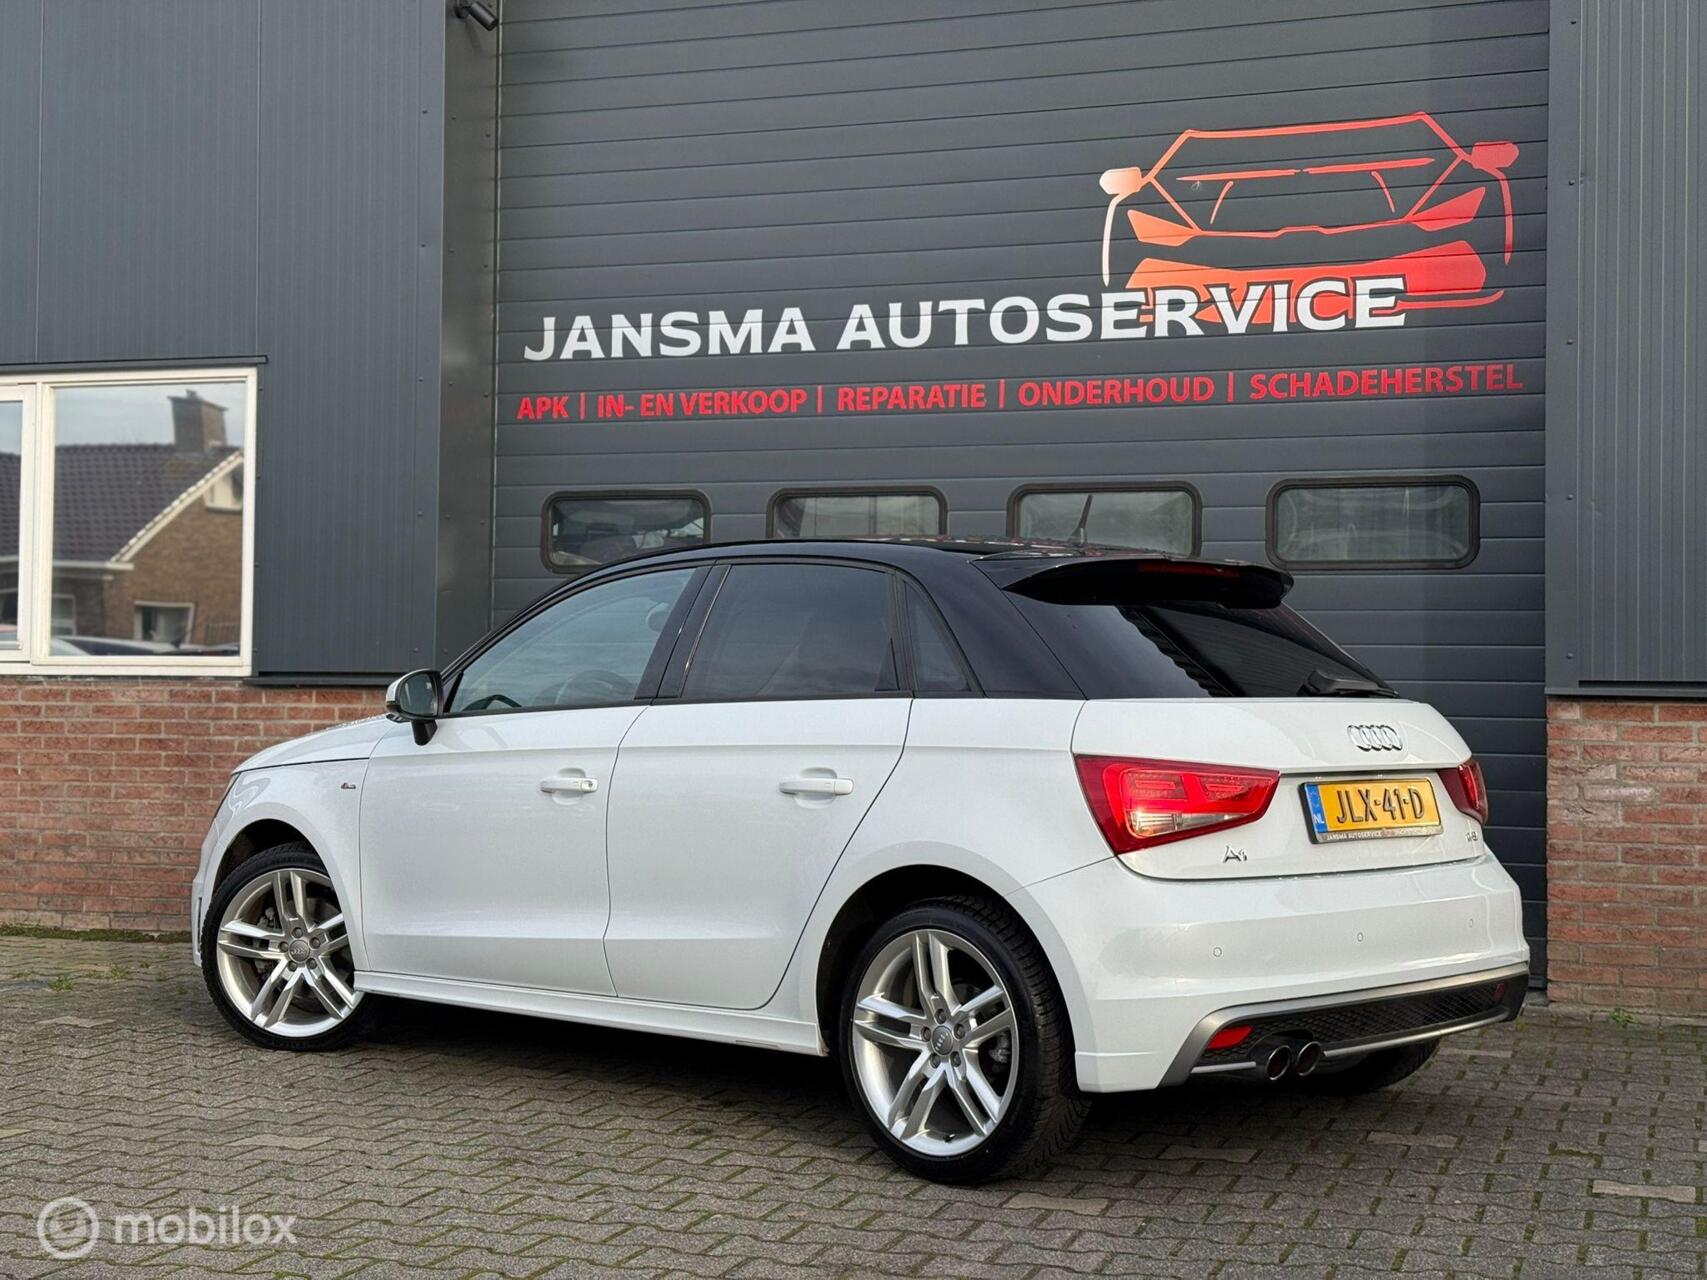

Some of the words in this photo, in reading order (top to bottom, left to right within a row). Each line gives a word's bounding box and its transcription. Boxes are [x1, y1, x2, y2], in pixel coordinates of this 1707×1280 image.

[523, 306, 816, 361] JANSMA
[836, 277, 1407, 350] AUTOSERVICE
[517, 396, 569, 420] APK
[598, 394, 635, 418] IN-
[640, 393, 674, 417] EN
[680, 388, 808, 417] VERKOOP
[837, 383, 986, 413] REPARATIE
[1018, 375, 1216, 407] ONDERHOUD
[1249, 363, 1524, 401] SCHADEHERSTEL
[1336, 788, 1425, 824] JLX-41-D
